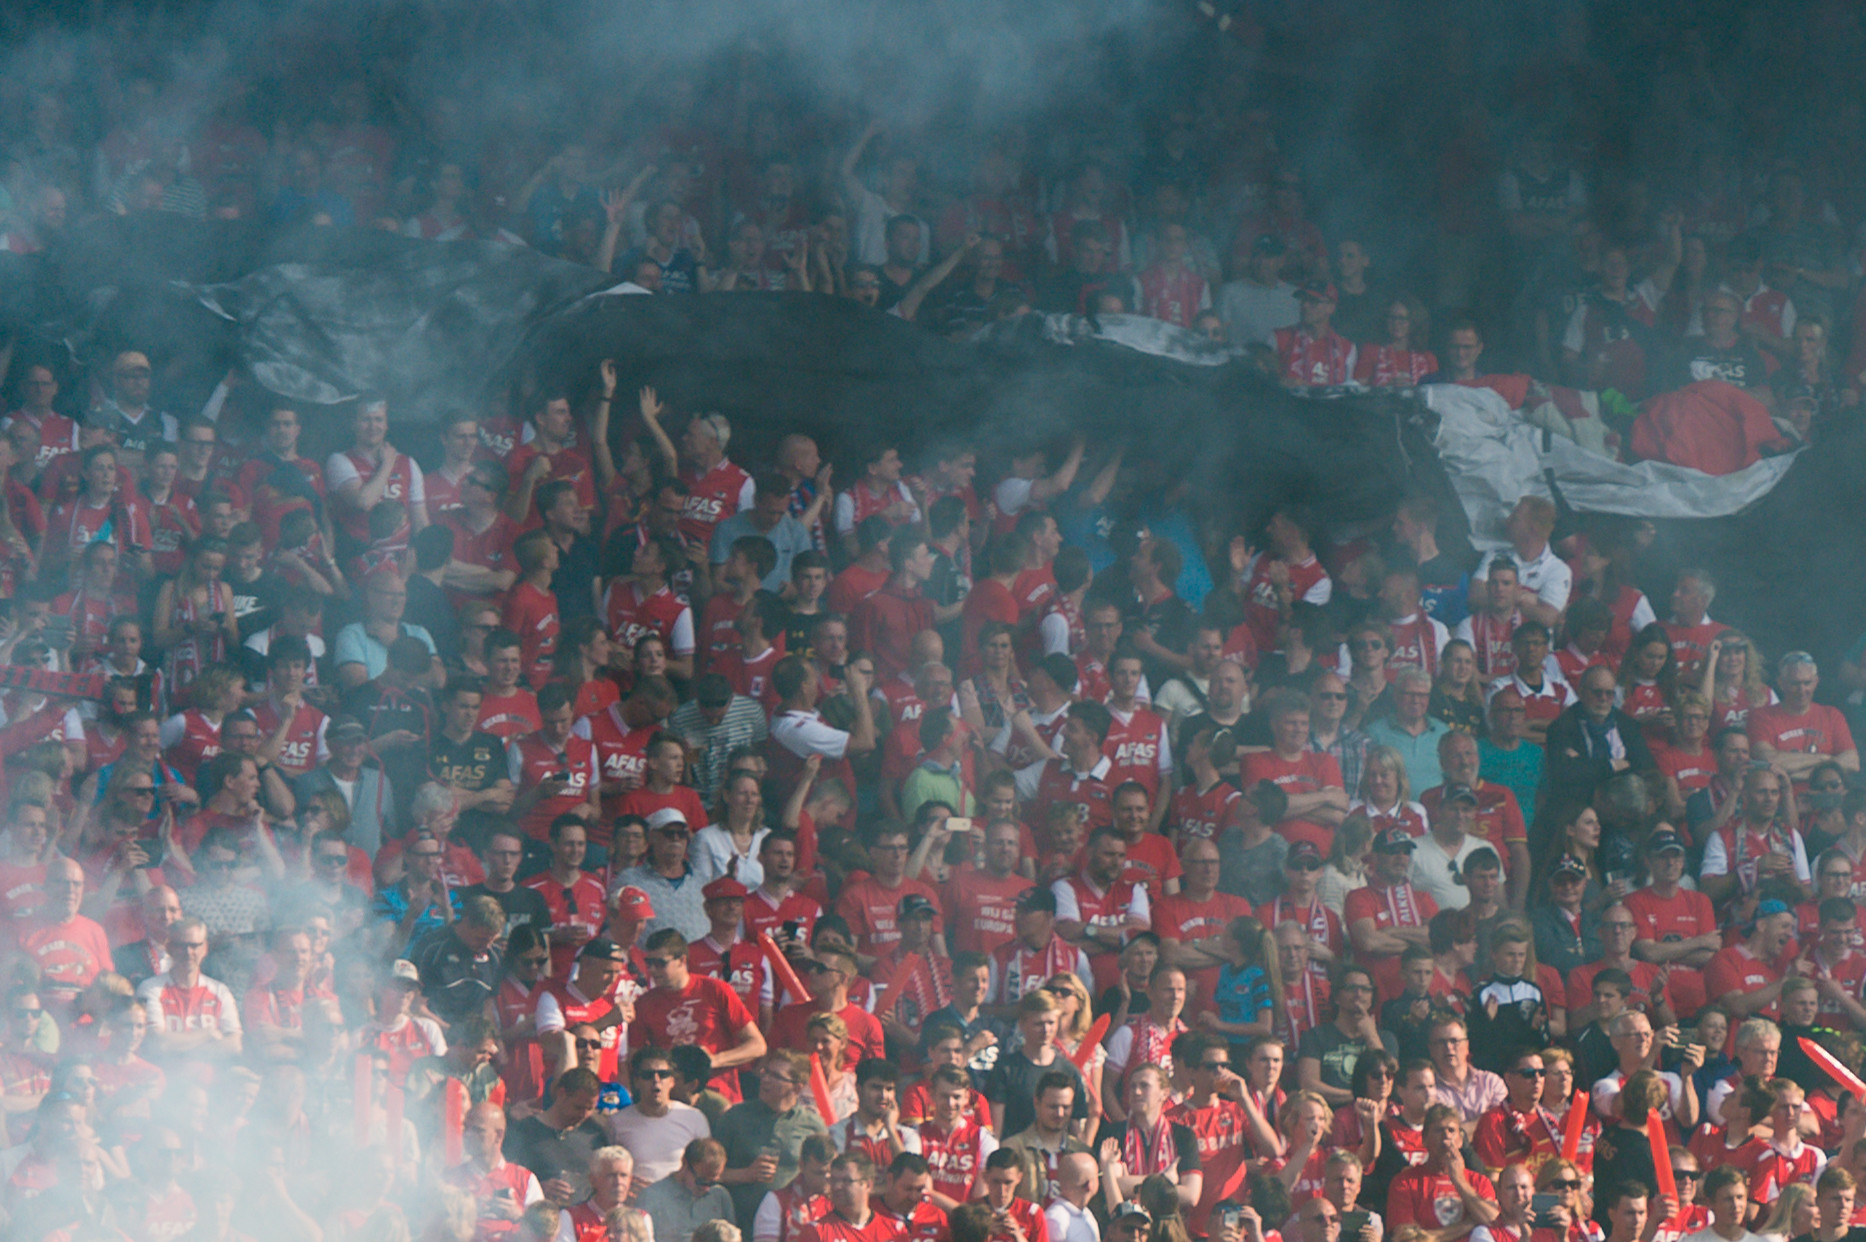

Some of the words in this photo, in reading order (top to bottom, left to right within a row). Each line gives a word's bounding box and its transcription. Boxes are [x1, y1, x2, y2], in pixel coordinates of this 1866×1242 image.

[1115, 743, 1157, 759] AFAS
[440, 764, 486, 781] AFAS
[708, 970, 754, 985] AAS
[928, 1151, 974, 1170] AFAS
